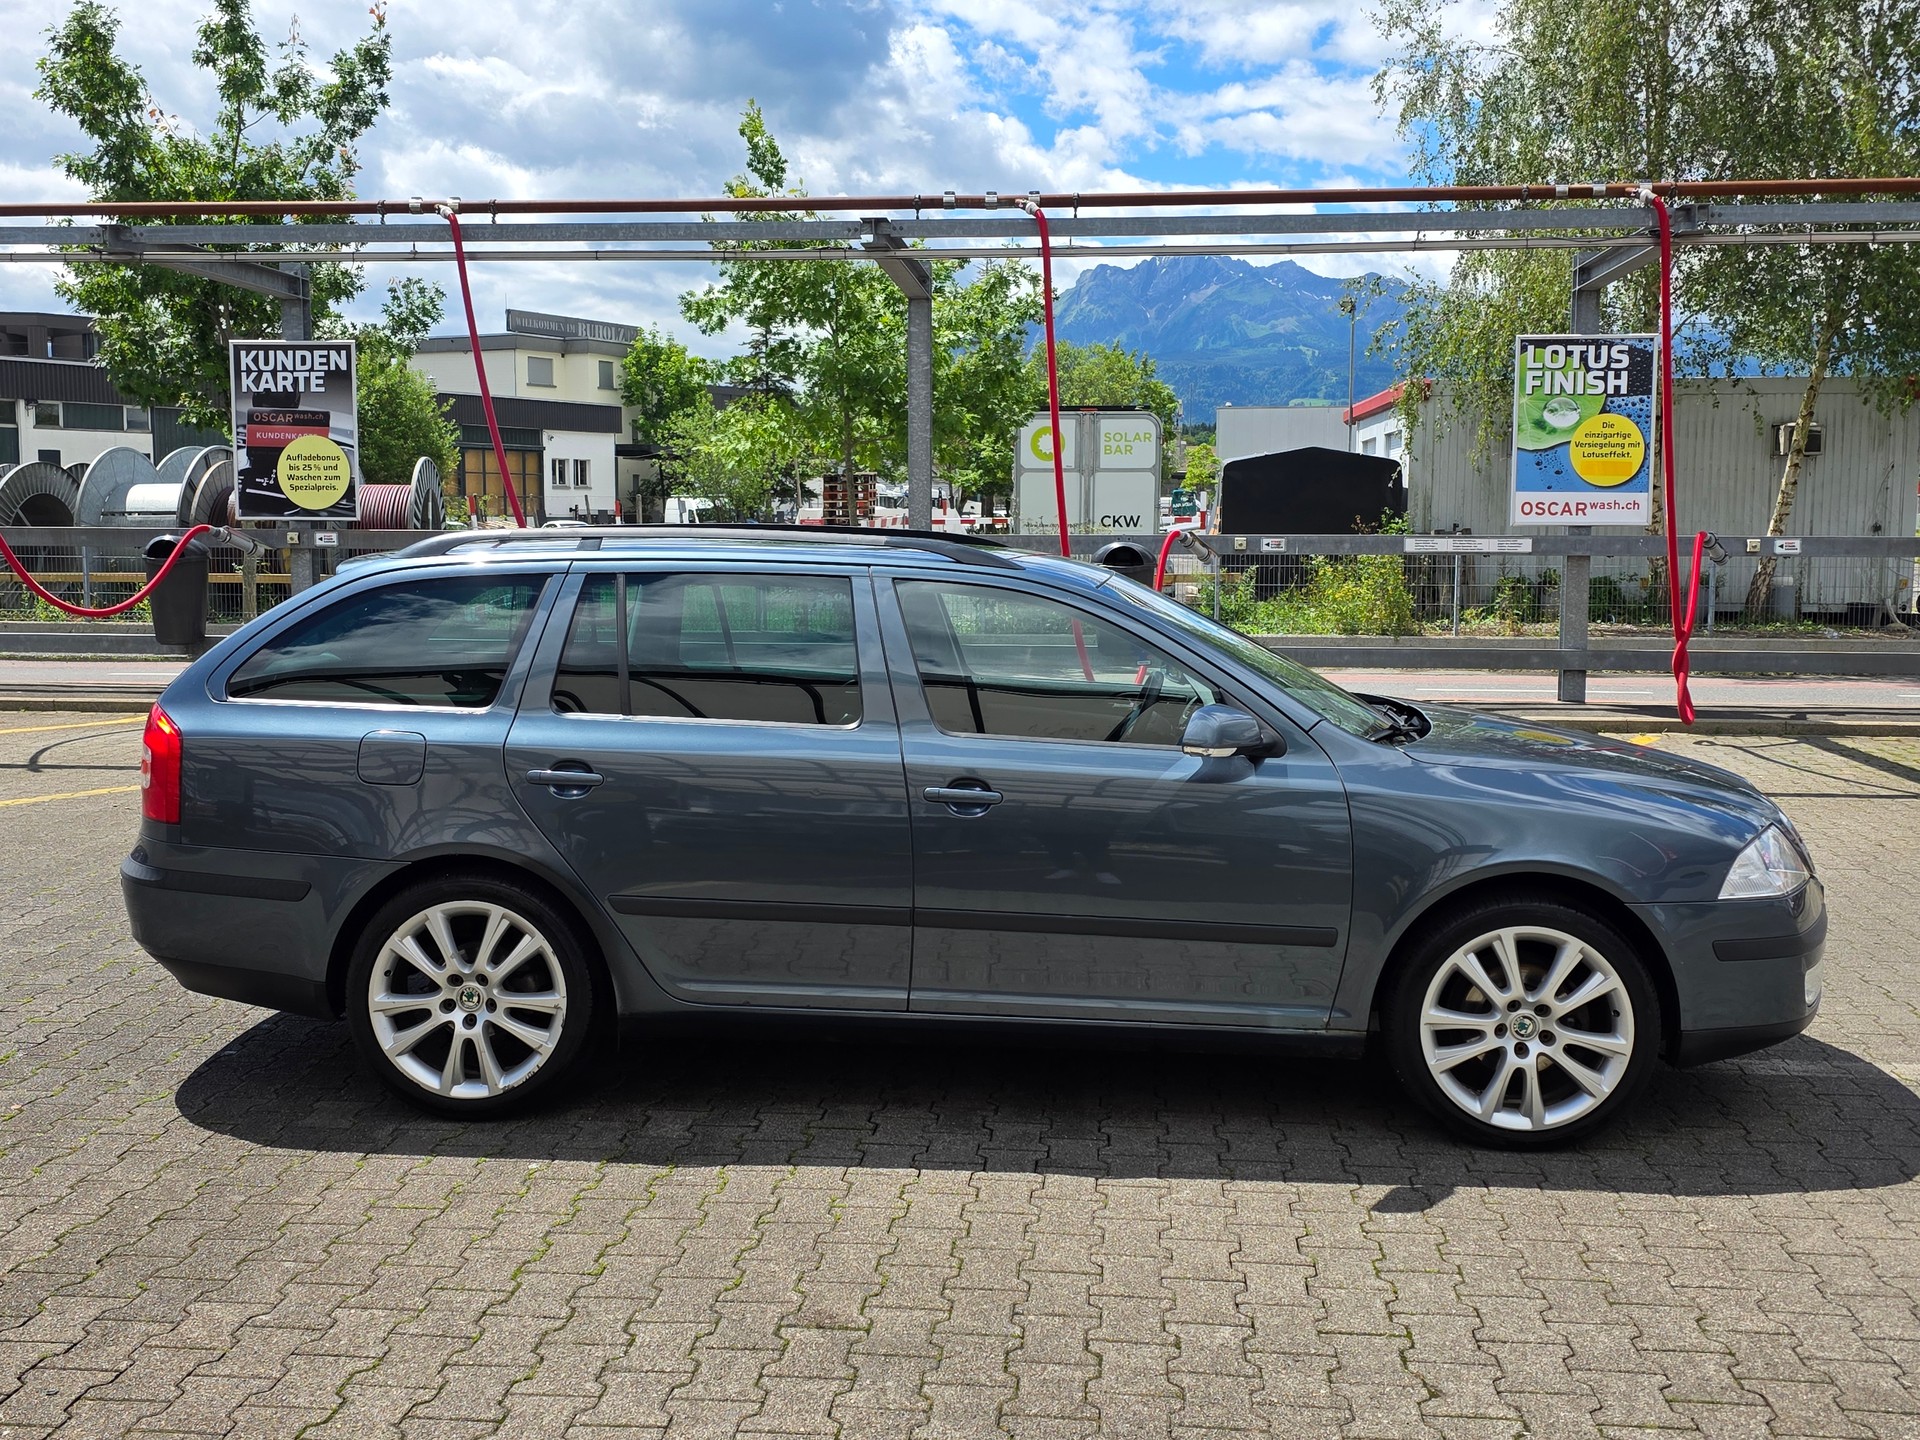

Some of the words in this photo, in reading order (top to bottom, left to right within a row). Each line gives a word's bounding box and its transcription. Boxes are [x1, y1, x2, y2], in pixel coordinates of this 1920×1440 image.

[515, 316, 565, 332] WILLKOMMEN
[578, 322, 626, 342] BUHOLZ
[240, 350, 347, 371] KUNDEN
[1526, 344, 1630, 369] LOTUS
[241, 371, 326, 393] KARTE
[1525, 370, 1628, 395] FINISH
[1602, 421, 1615, 429] Die
[256, 431, 318, 440] KUNDENKA
[1103, 432, 1152, 443] SOLAR
[1584, 431, 1632, 440] einzigartige
[1103, 445, 1133, 455] BAR
[1574, 441, 1626, 450] Versiegelung
[286, 453, 341, 462] Aufladebonus
[1582, 451, 1632, 459] Lotuseffekt.
[288, 463, 300, 471] bis
[323, 463, 338, 471] und
[286, 473, 322, 481] Waschen
[289, 483, 339, 492] Spezialpreis.
